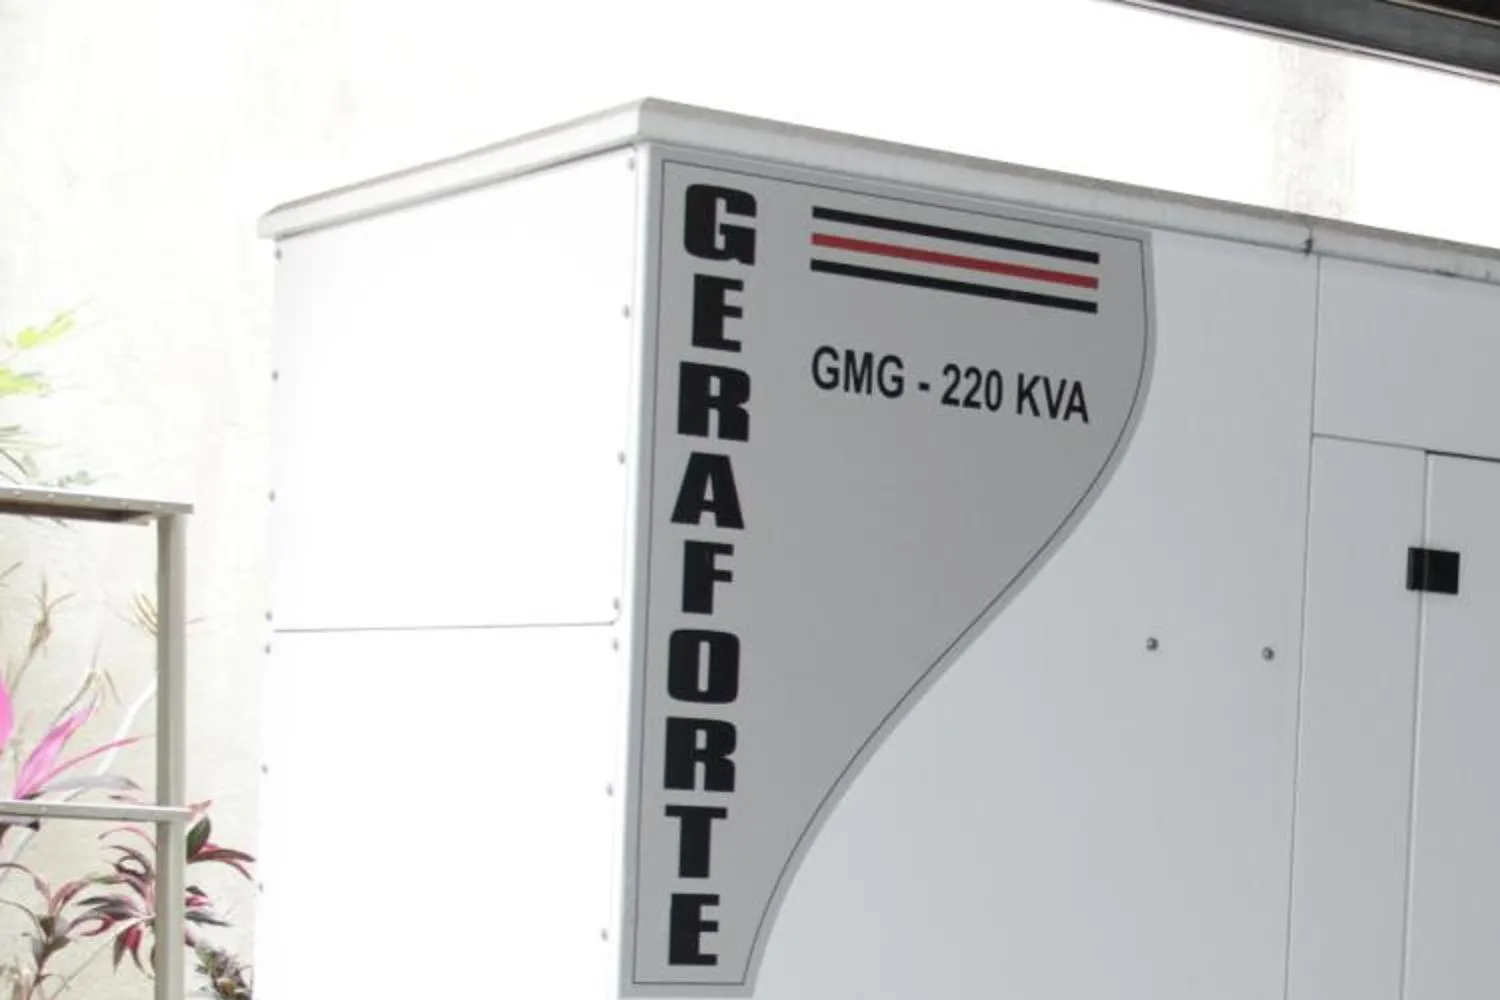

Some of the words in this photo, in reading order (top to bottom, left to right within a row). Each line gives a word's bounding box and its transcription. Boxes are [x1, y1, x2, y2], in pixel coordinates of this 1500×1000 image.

[664, 183, 757, 967] GERAFORTE
[811, 345, 904, 399] GMG
[941, 362, 1003, 412] 220
[1015, 373, 1090, 425] KVA
